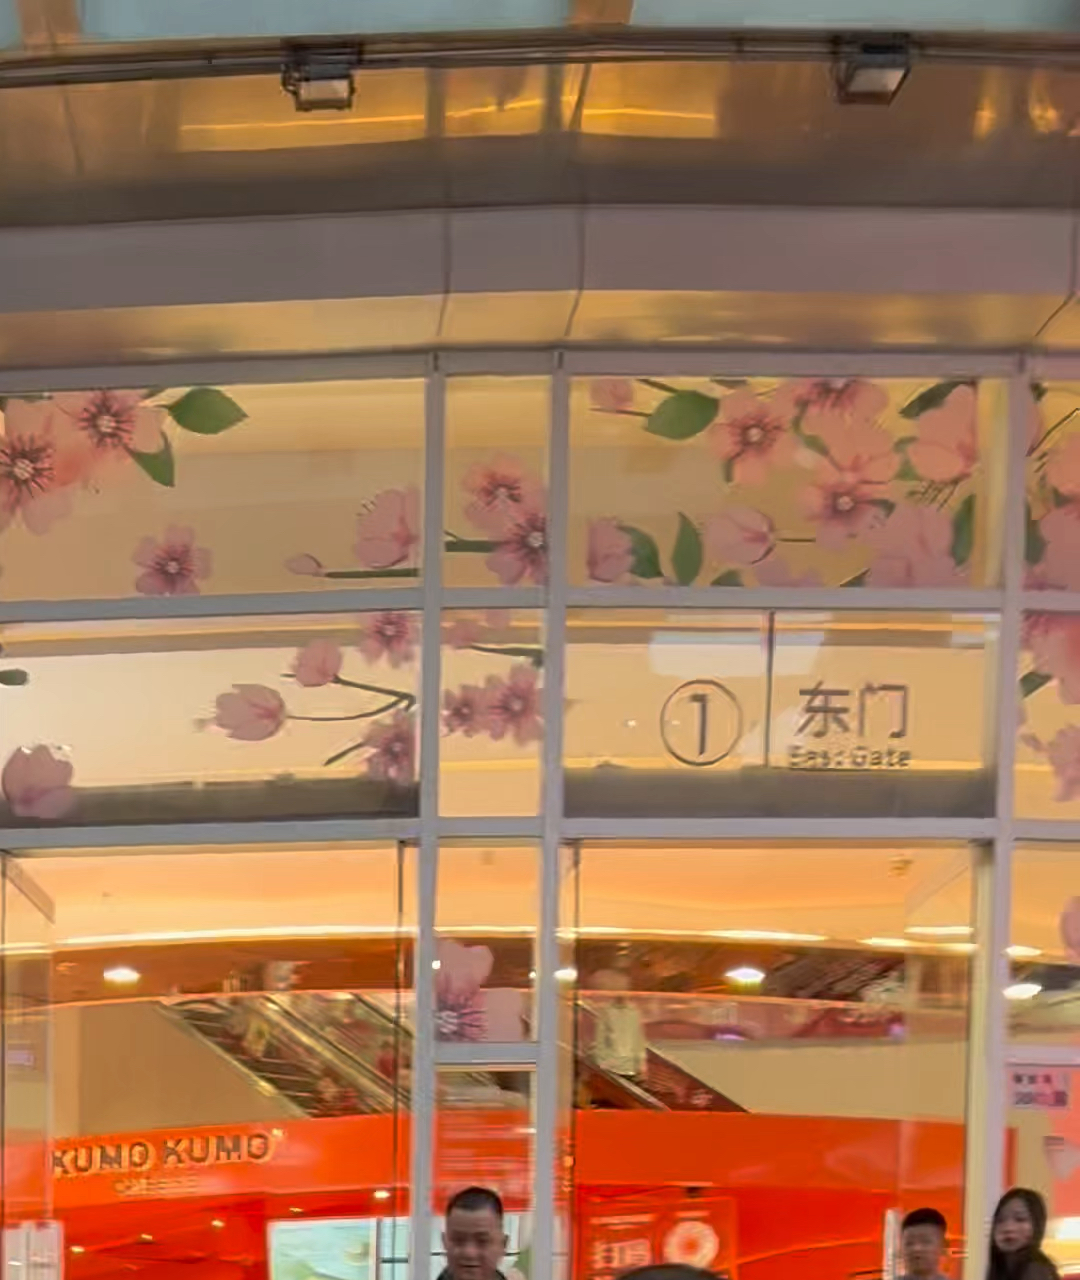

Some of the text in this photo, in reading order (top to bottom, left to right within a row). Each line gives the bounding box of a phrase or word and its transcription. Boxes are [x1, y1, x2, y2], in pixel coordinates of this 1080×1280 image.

[794, 680, 909, 739] 东门
[851, 744, 911, 768] Gate
[52, 1132, 273, 1177] KUMO KUMO
